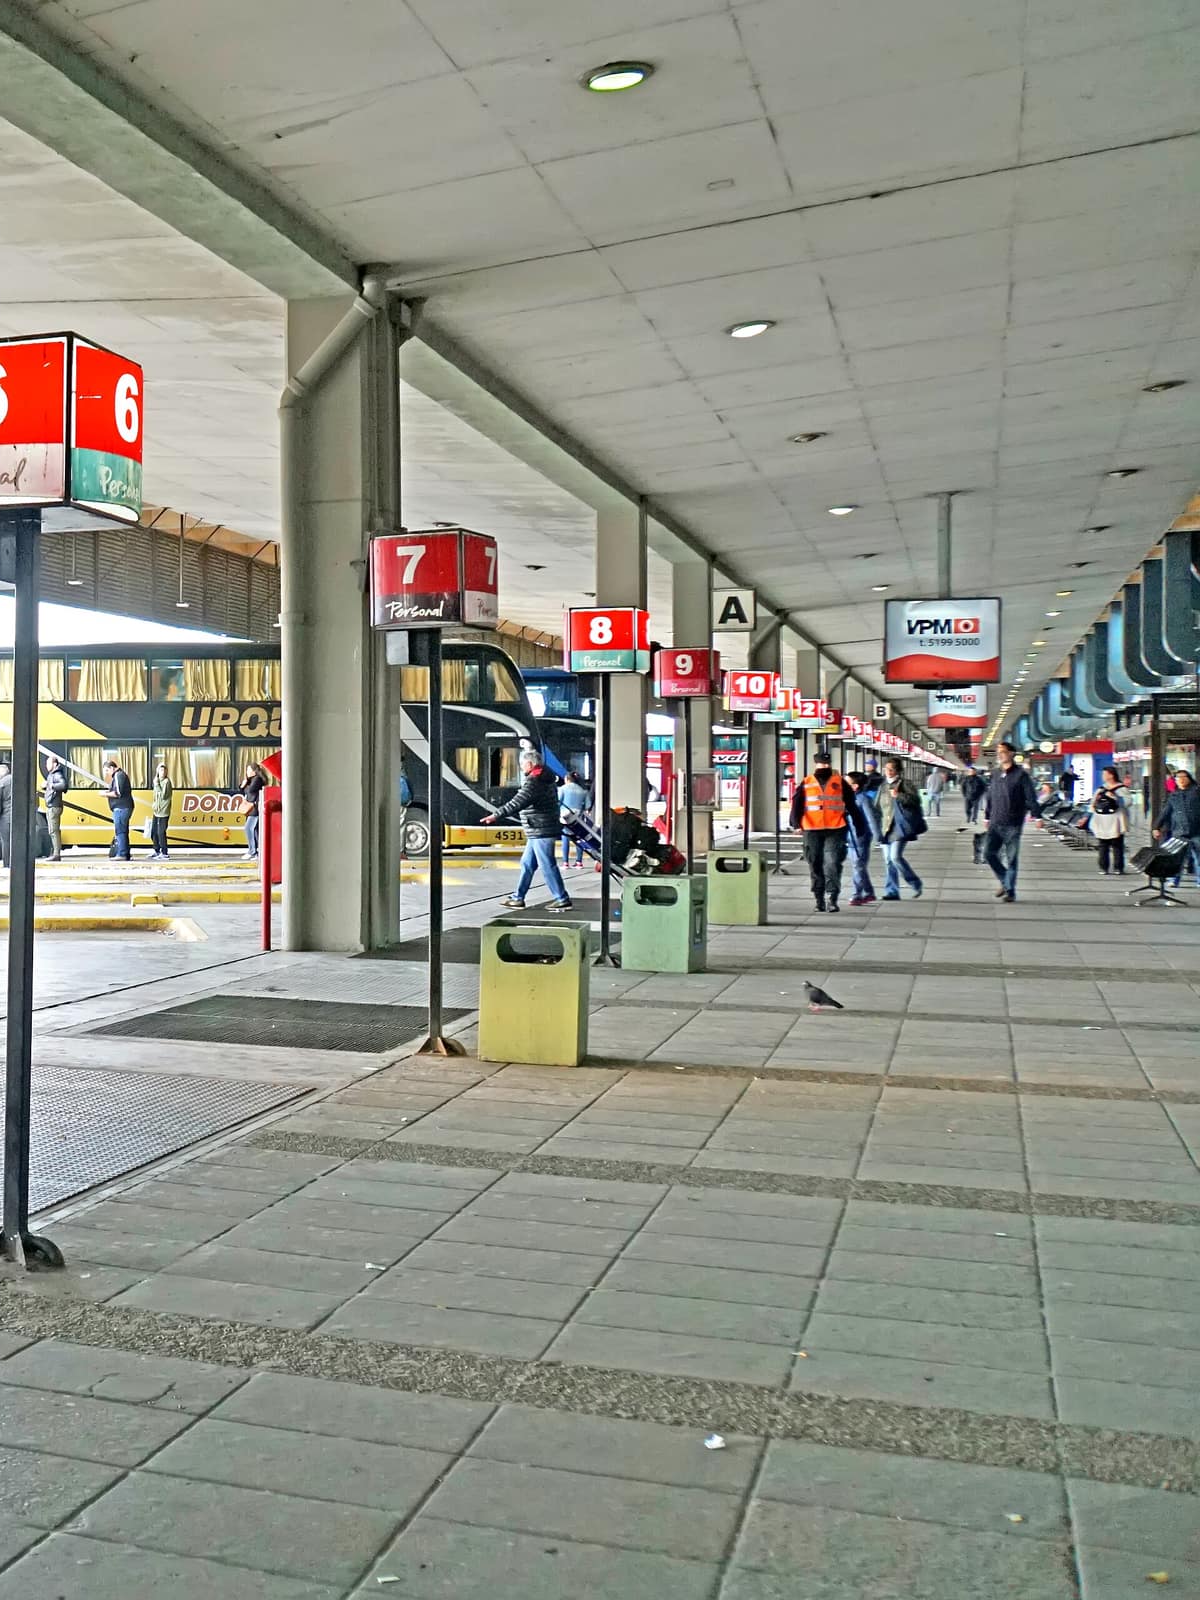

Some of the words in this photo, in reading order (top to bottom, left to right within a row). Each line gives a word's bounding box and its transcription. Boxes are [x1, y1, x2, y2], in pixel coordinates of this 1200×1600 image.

[114, 373, 139, 443] 6
[396, 545, 427, 585] 7
[484, 546, 497, 586] 7
[385, 601, 444, 620] Personal
[718, 596, 749, 624] A
[589, 616, 613, 645] 8
[907, 619, 952, 635] VPM
[928, 638, 953, 647] 5199
[955, 638, 980, 647] 5000
[675, 653, 694, 676] 9
[735, 675, 766, 695] 10
[876, 706, 887, 717] B
[181, 813, 224, 823] suite
[494, 831, 524, 841] 4531
